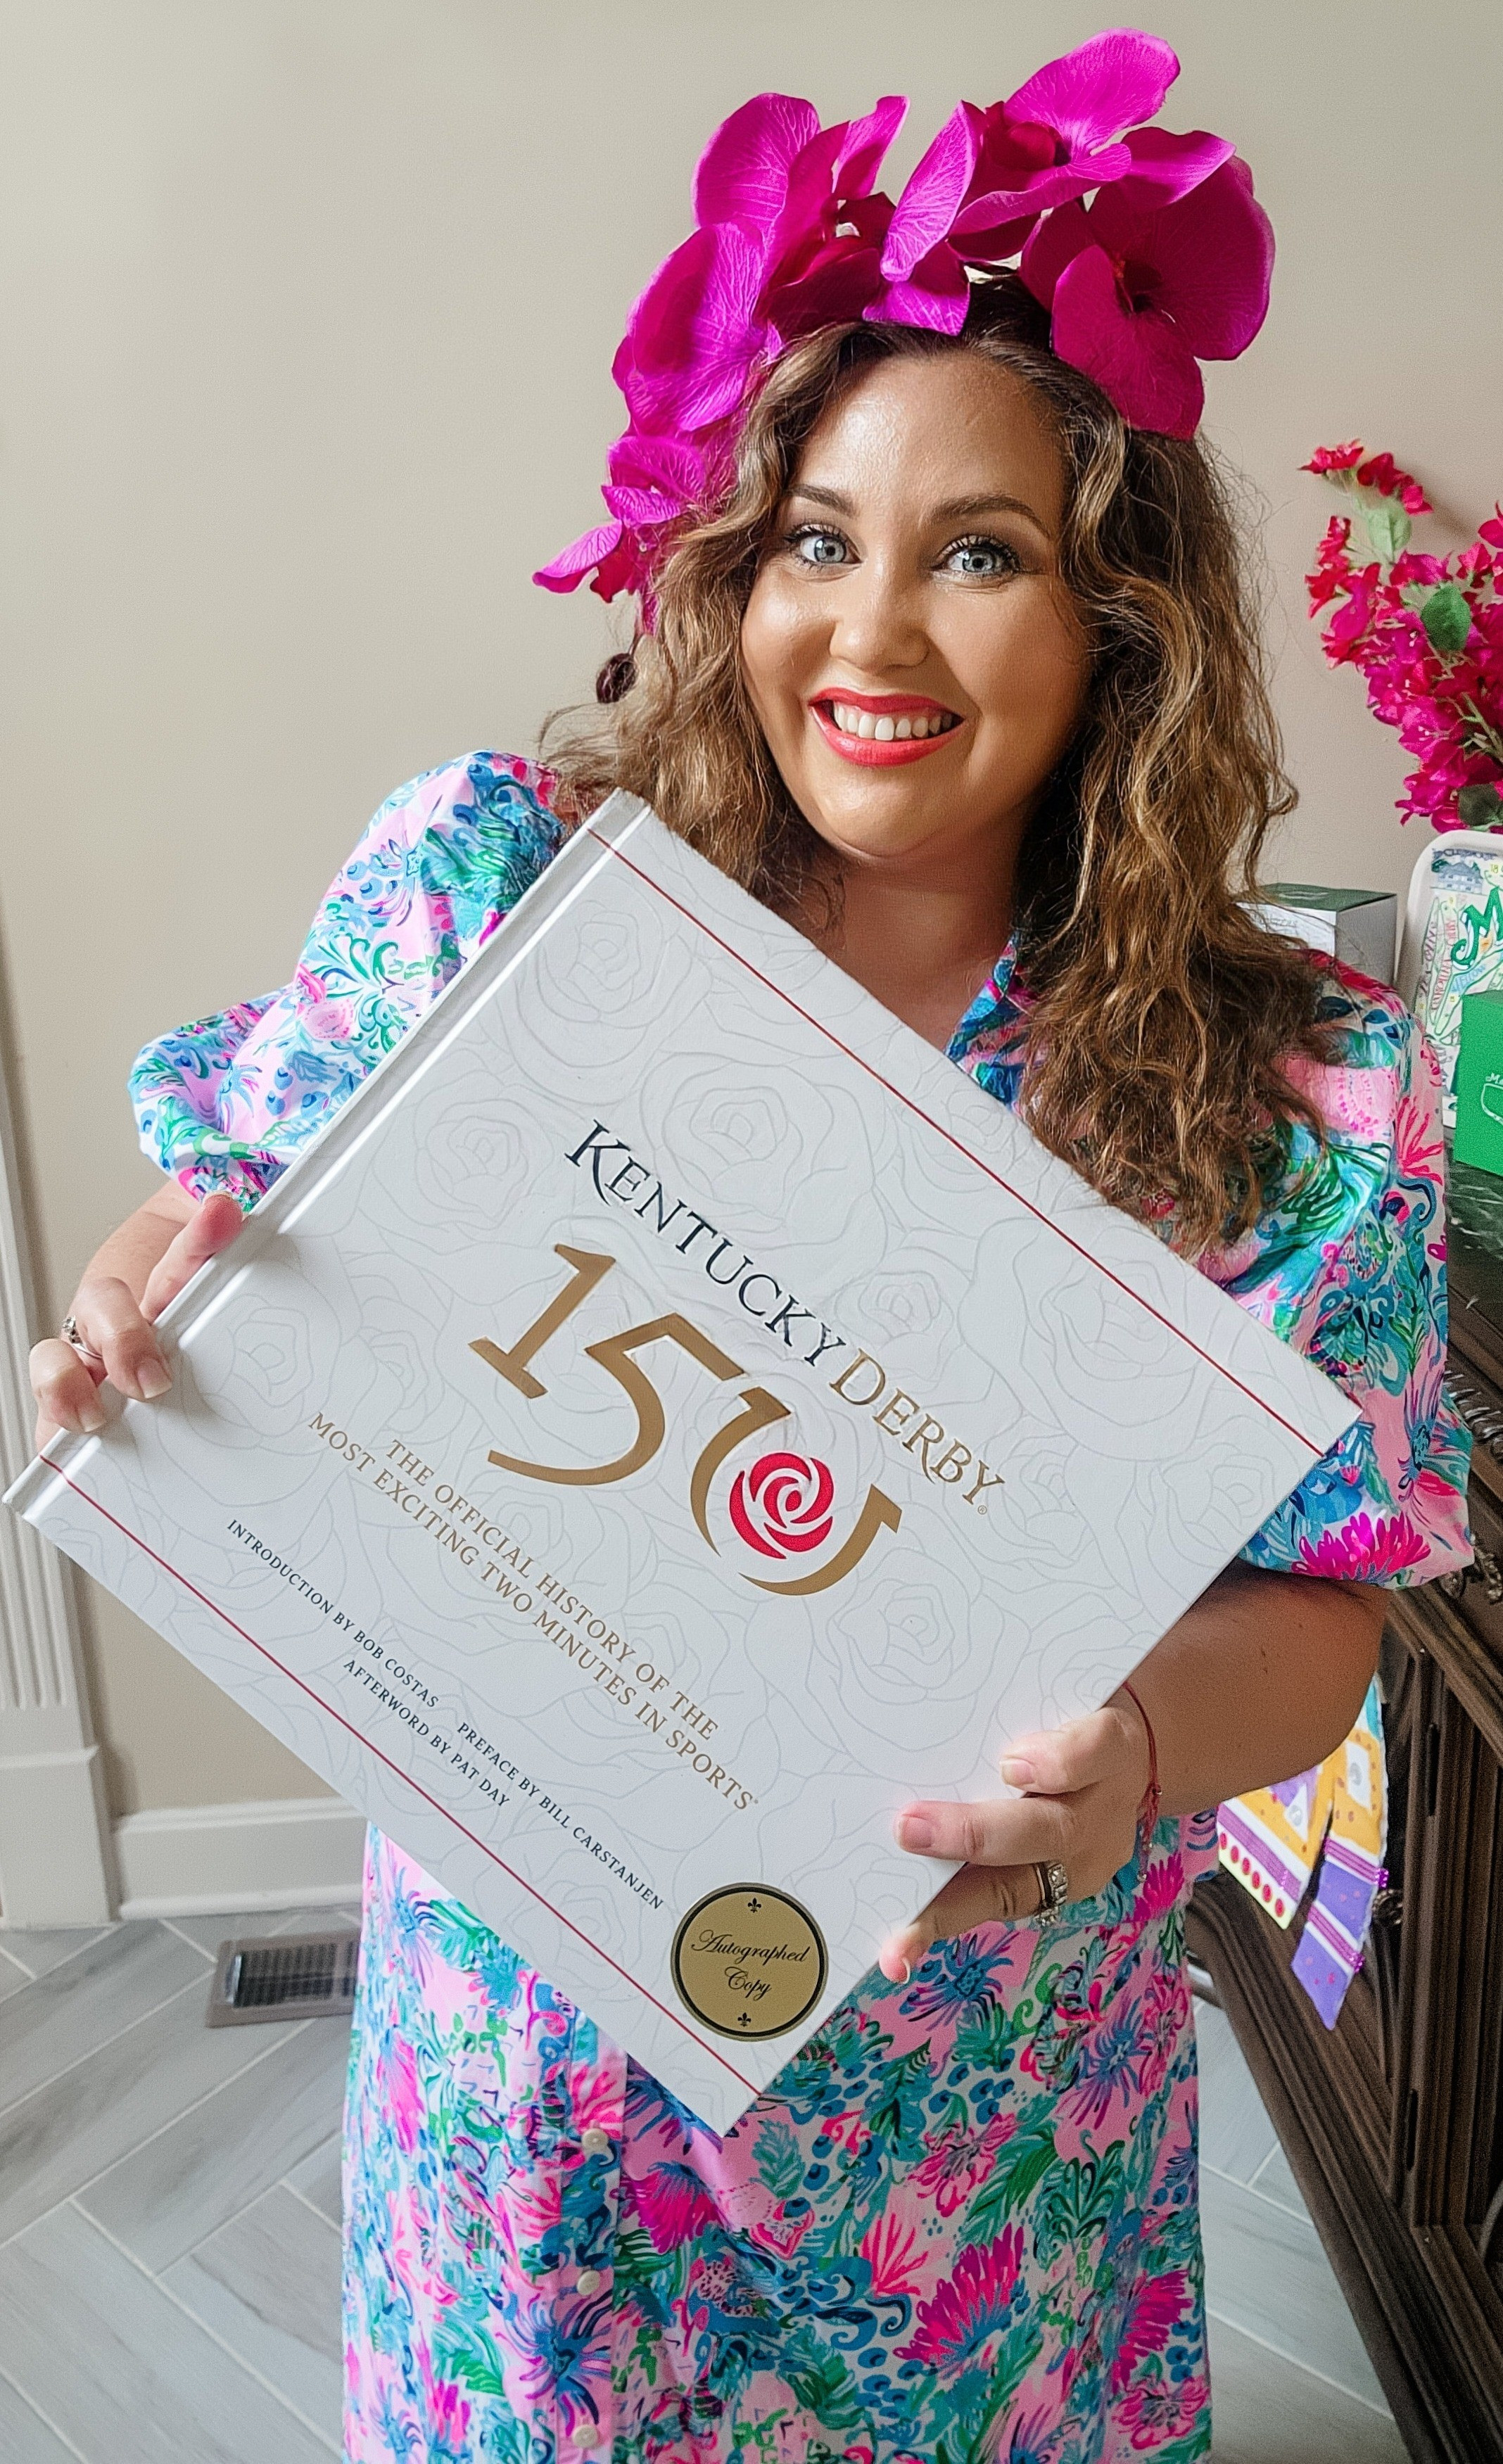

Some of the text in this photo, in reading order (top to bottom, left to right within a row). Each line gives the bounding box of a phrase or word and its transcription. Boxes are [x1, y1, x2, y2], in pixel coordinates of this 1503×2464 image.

[564, 1119, 846, 1367] KENTUCKY
[308, 1412, 376, 1471] MOST
[373, 1468, 479, 1566] EXCITING
[481, 1561, 532, 1612] TWO
[532, 1609, 637, 1705] MINUTES
[635, 1701, 668, 1732] IN
[386, 1440, 718, 1740] THE OFFICIAL HISTORY OF THE
[227, 1520, 664, 1909] INTRODUCTION BY BOB COSTAS PREFACE BY BILL CARSTANJEN
[343, 1660, 509, 1806] AFTERWORD BY PAT DAY
[691, 1929, 811, 1966] Autographed
[724, 1967, 772, 2001] Copy
